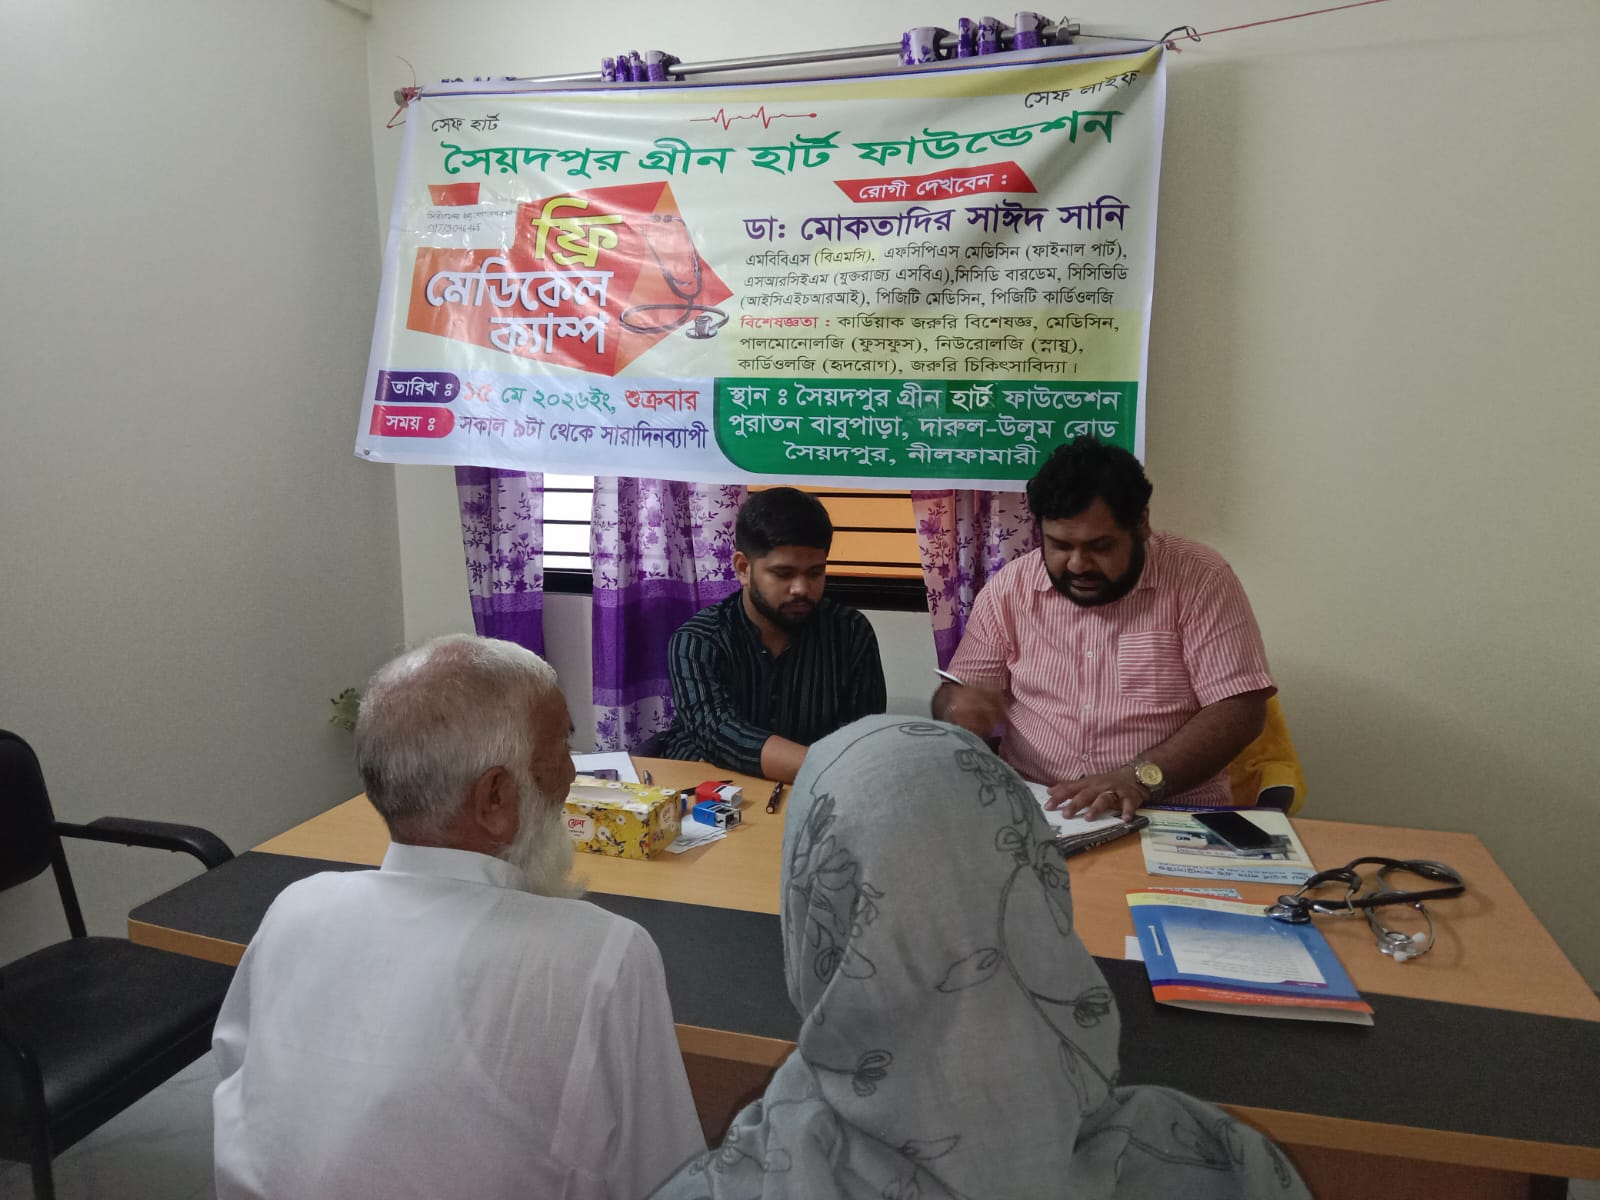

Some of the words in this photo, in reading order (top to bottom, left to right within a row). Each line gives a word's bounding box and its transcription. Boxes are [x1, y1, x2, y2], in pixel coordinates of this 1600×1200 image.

[1025, 89, 1072, 108] সেফ
[1080, 70, 1140, 94] লাইফ
[432, 117, 465, 132] সেফ
[470, 112, 500, 131] হার্ট
[440, 141, 630, 179] সৈয়দপুর
[639, 137, 736, 175] গ্রীন
[747, 130, 842, 175] হার্ট
[852, 110, 1124, 166] ফাউন্ডেশন
[859, 181, 910, 200] রোগী
[916, 174, 994, 197] দেখবেন
[531, 197, 623, 268] ফ্রি
[801, 206, 956, 242] মোকতাদির
[965, 199, 1049, 234] সাঈদ
[1057, 194, 1131, 230] সানি
[746, 250, 811, 266] এমবিবিএস
[884, 241, 960, 259] এফসিপিএস
[964, 242, 1021, 259] মেডিসিন
[1025, 241, 1086, 261] (ফাইনাল
[1091, 239, 1127, 260] পার্ট),
[426, 256, 614, 311] মেডিকেল
[744, 271, 829, 288] এসআরসিইএম
[834, 268, 891, 287] (যুক্তরাজ্য
[1005, 267, 1061, 283] বারডেম,
[1067, 263, 1129, 281] সিসিভিডি
[876, 287, 922, 306] পিজিটি
[926, 288, 985, 307] মেডিসিন,
[991, 287, 1038, 305] পিজিটি
[1043, 286, 1115, 305] কার্ডিওলজি
[489, 312, 610, 354] ক্যাম্প
[740, 315, 819, 329] বিশেষজ্ঞতা
[836, 312, 905, 330] কার্ডিয়াক
[911, 314, 959, 330] জরুরি
[965, 314, 1038, 331] বিশেষজ্ঞ,
[1047, 312, 1119, 332] মেডিসিন,
[740, 334, 846, 351] পালমোনোলজি
[852, 337, 928, 353] (ফুসফুস),
[935, 335, 1025, 351] নিউরোলজি
[1032, 336, 1084, 354] (স্নায়ু),
[737, 355, 817, 371] কার্ডিওলজি
[823, 358, 903, 375] (হৃদরোগ),
[911, 357, 959, 373] জরুরি
[965, 357, 1068, 374] চিকিৎসাবিদ্যা
[391, 376, 439, 397] তারিখ
[464, 381, 493, 402] ১৫
[502, 387, 527, 404] মে
[533, 386, 616, 415] ২০২৬ইং,
[625, 388, 700, 412] শুক্রবার
[727, 385, 770, 410] স্থান
[794, 382, 892, 412] সৈয়দপুর
[897, 382, 944, 409] গ্রীন
[949, 383, 994, 412] হার্ট
[1002, 384, 1122, 411] ফাউন্ডেশন
[386, 415, 423, 431] সময়
[459, 415, 508, 437] সকাল
[513, 414, 545, 439] ৯টা
[550, 421, 596, 443] থেকে
[600, 420, 709, 449] সারাদিনব্যাপী
[728, 413, 803, 438] পুরাতন
[808, 415, 909, 440] বাবুপাড়া,
[918, 413, 1056, 443] দারুল-উলুম
[1064, 418, 1120, 438] রোড
[783, 440, 896, 466] সৈয়দপুর,
[905, 442, 1040, 465] নীলফামারী
